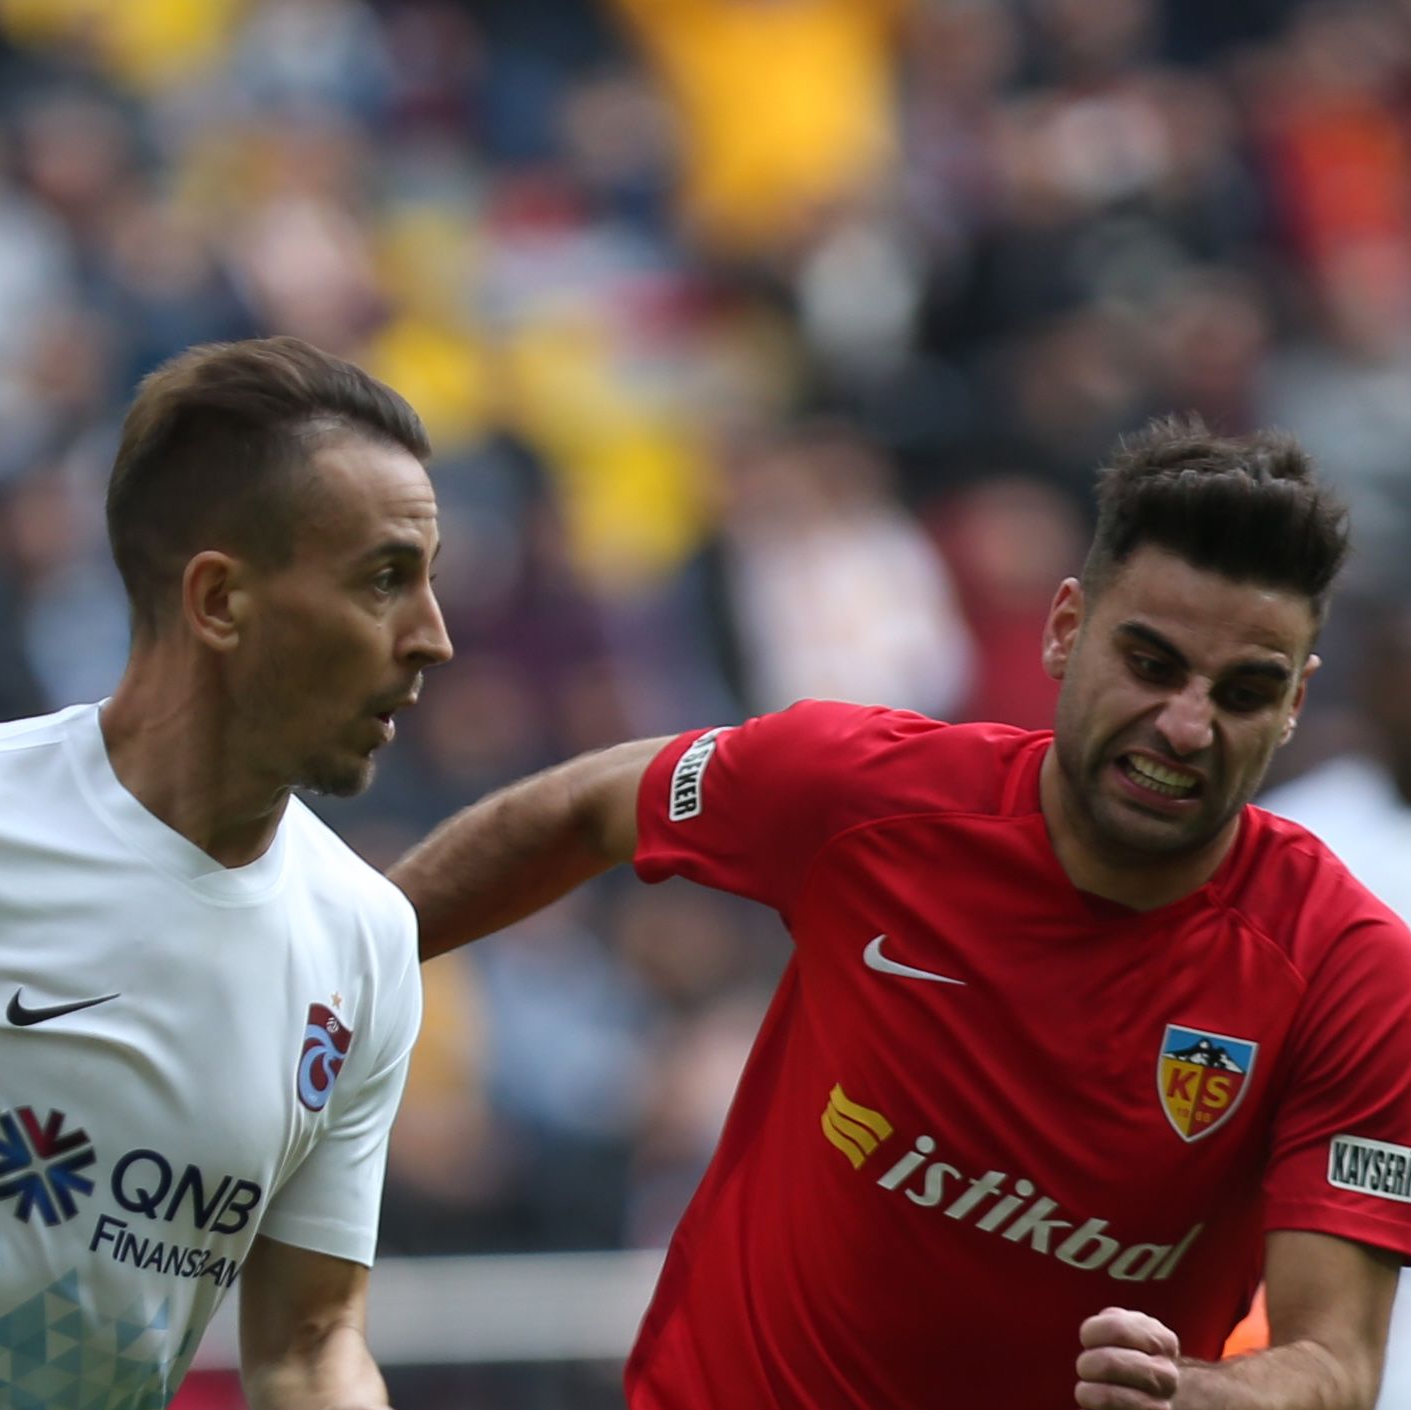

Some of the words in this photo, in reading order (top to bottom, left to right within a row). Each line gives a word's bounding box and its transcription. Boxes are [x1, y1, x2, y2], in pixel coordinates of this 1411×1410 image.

[1166, 1067, 1230, 1109] KS
[111, 1148, 261, 1234] QNB
[877, 1135, 1205, 1281] istikbal
